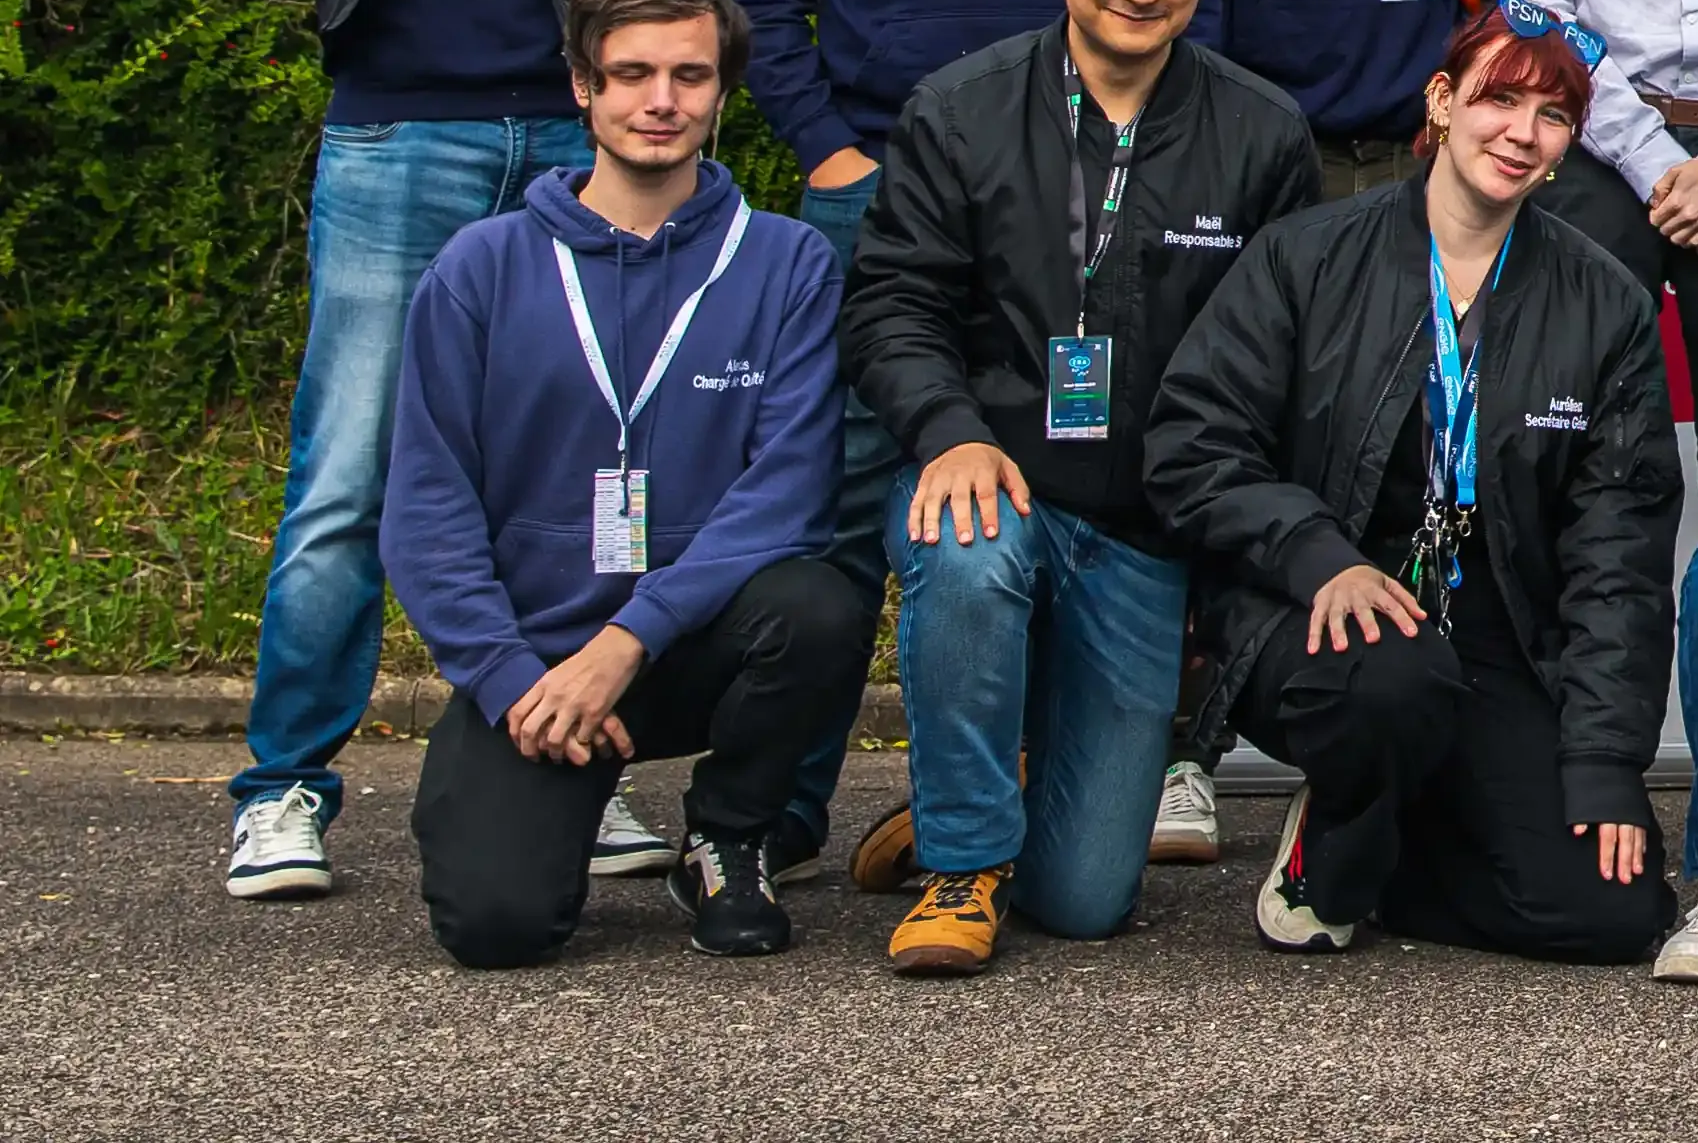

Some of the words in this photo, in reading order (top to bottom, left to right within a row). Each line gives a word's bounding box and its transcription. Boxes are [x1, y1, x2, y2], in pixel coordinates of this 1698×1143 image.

[1564, 25, 1602, 55] PSN
[1195, 215, 1222, 230] Maël
[1164, 230, 1235, 249] Responsable
